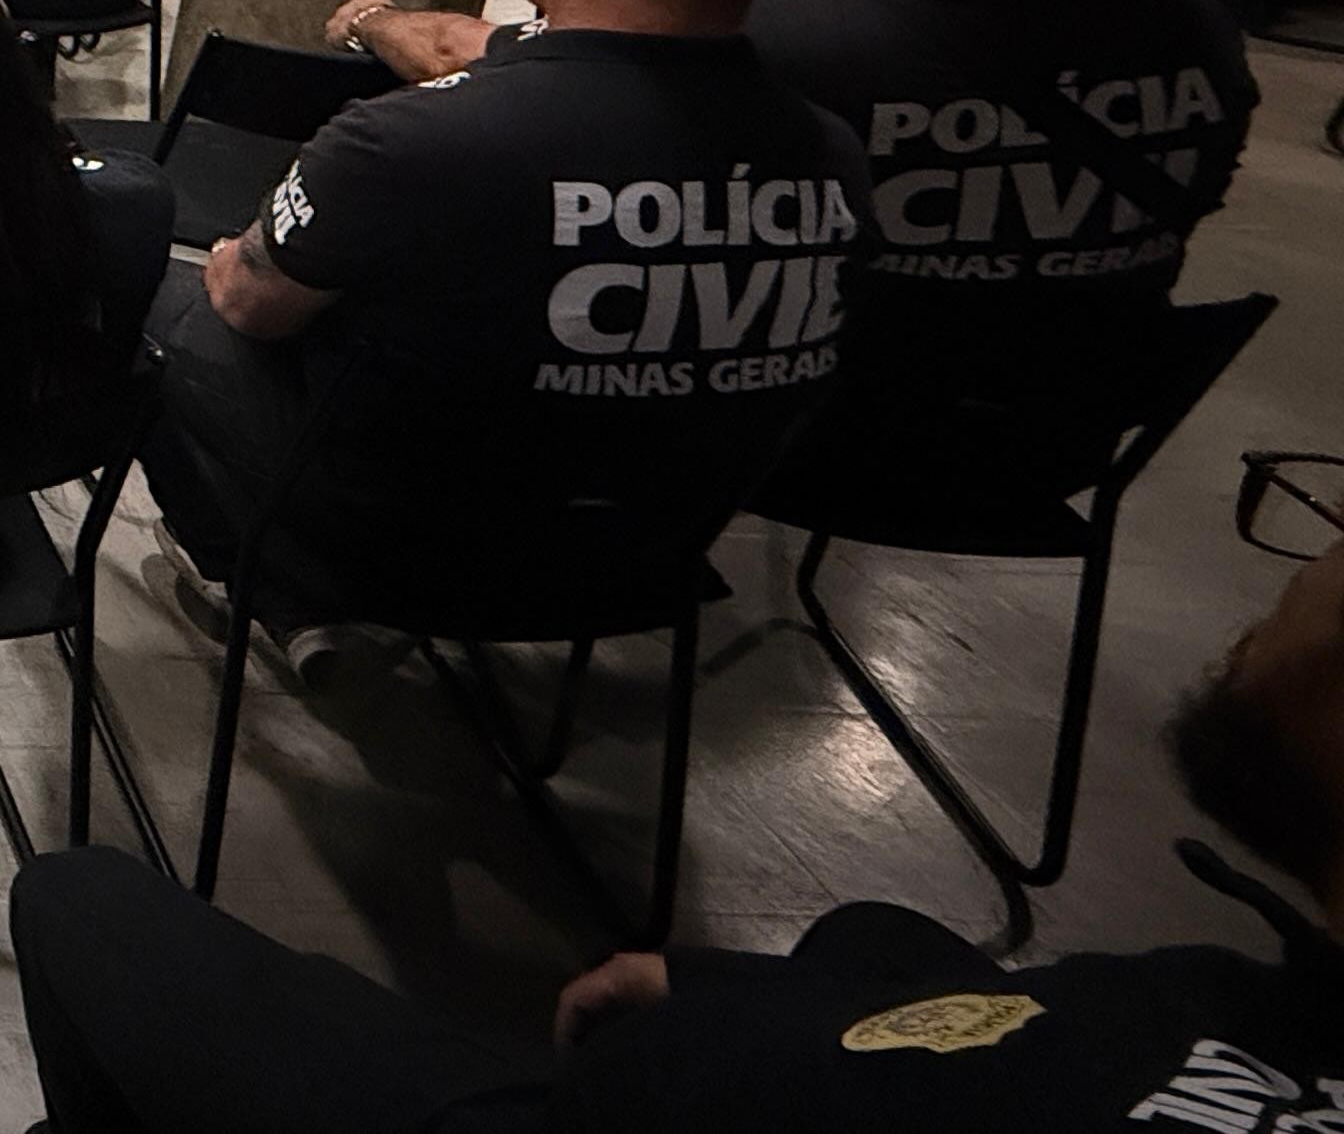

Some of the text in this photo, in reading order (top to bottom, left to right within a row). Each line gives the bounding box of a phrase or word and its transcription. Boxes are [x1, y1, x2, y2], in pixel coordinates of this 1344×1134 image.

[552, 165, 859, 249] POLÍCIA
[547, 257, 849, 356] CIVIL
[533, 361, 696, 399] MINAS
